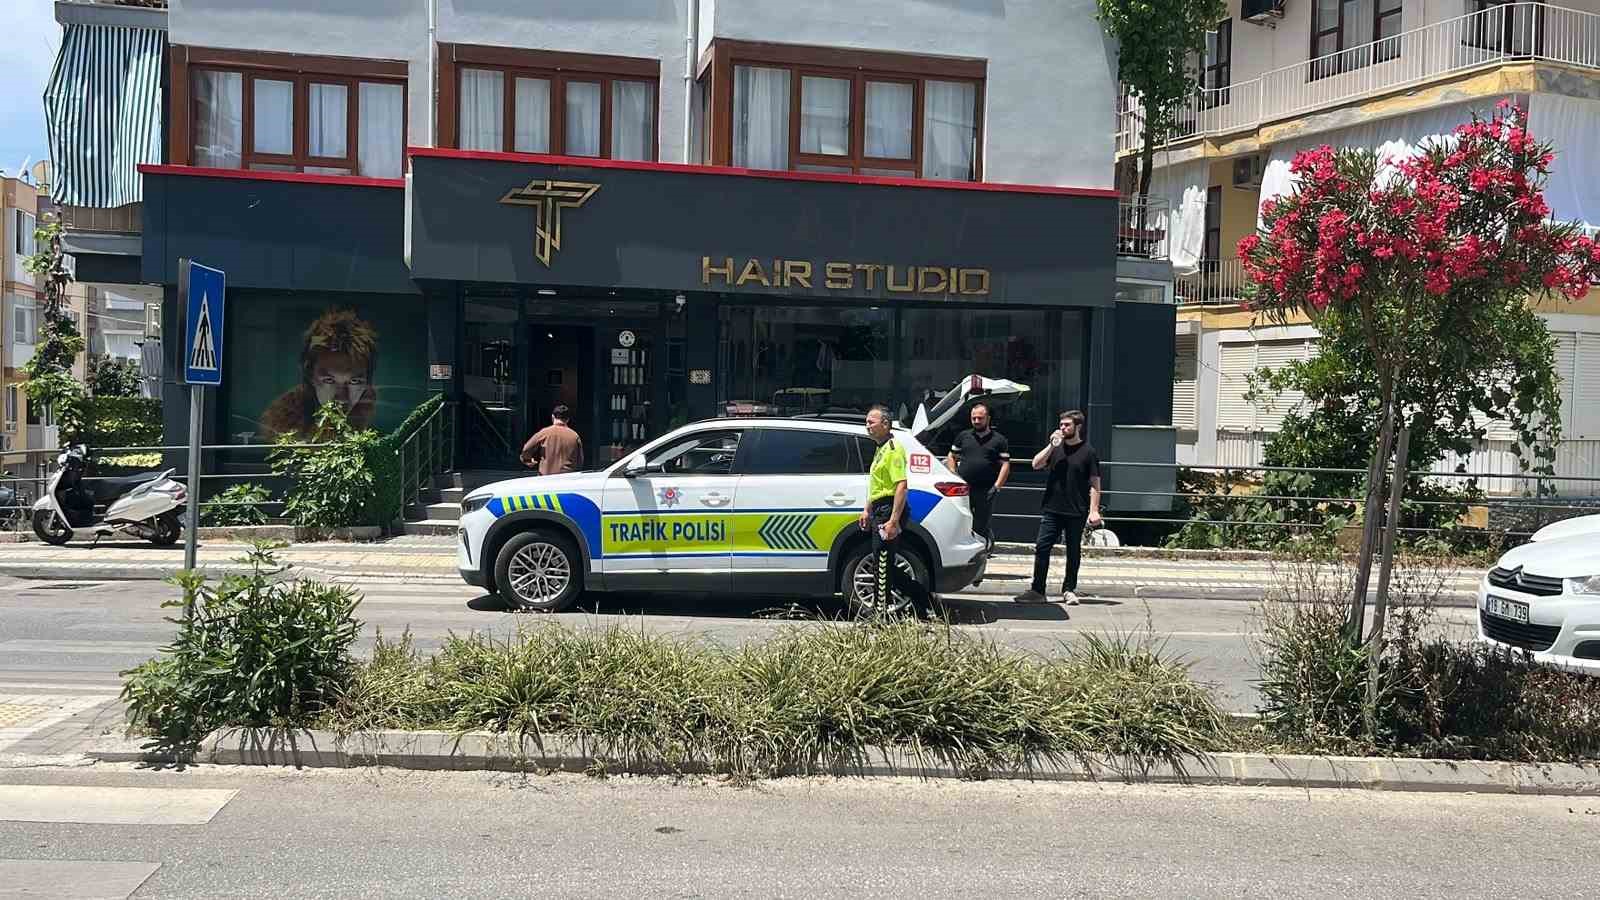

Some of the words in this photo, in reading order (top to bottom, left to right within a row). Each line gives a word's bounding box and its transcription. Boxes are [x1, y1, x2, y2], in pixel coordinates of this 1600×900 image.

[701, 256, 813, 289] HAIR
[825, 261, 991, 296] STUDIO
[912, 455, 929, 466] 112
[610, 519, 668, 542] TRAFİK
[672, 519, 726, 541] POLİSİ
